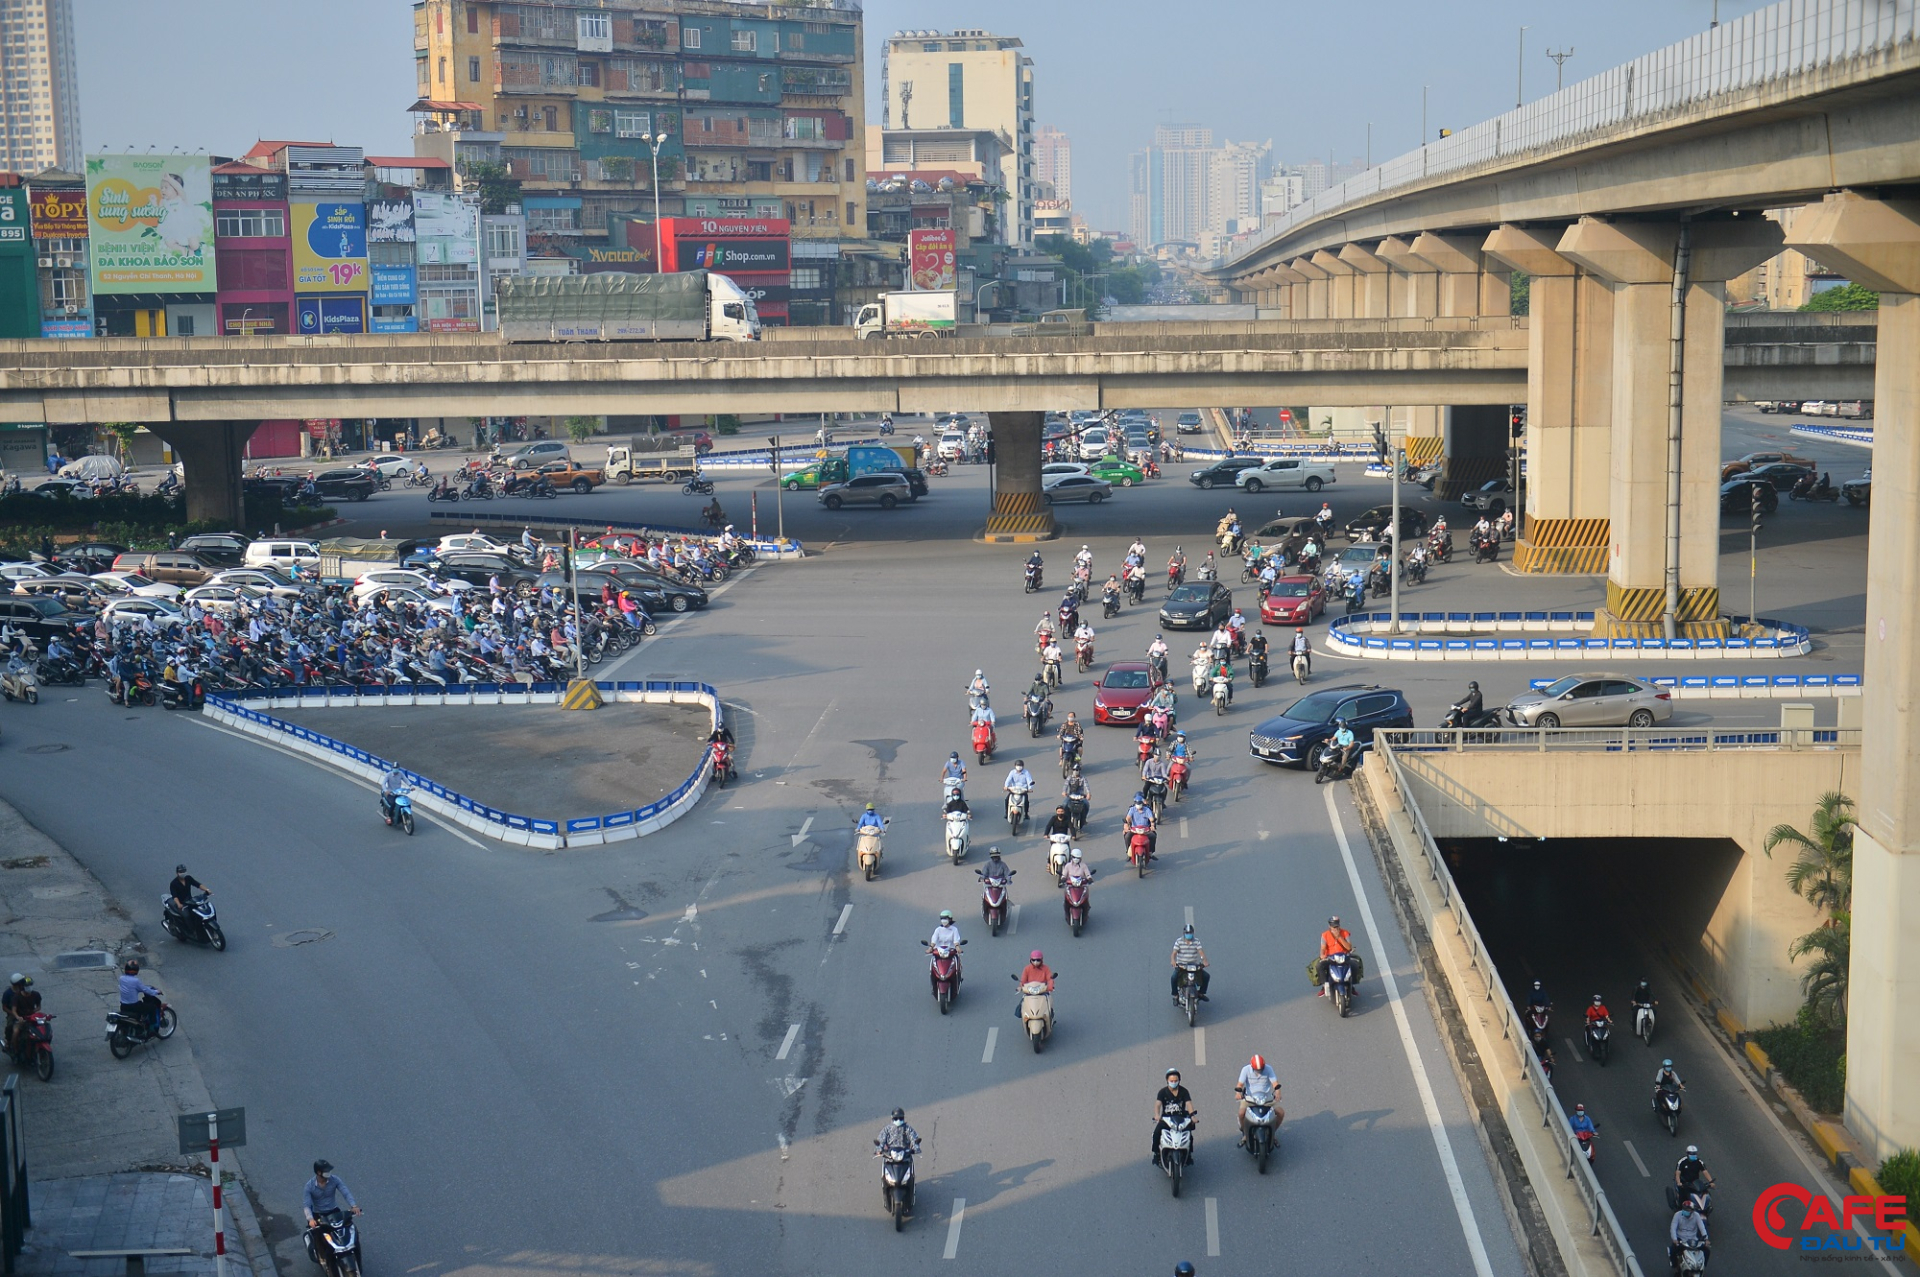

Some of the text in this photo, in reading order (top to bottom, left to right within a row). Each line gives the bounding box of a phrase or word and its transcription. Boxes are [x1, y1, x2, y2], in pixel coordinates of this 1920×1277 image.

[99, 187, 129, 205] Sinh
[234, 190, 247, 198] AN
[31, 202, 87, 218] TOPY
[98, 205, 128, 223] sung
[701, 220, 717, 233] 10
[1, 229, 21, 238] 895
[97, 241, 155, 255] BỆNH VIỆN
[98, 254, 204, 267] ĐA KHOA BẢO SƠN
[725, 250, 776, 264] Shop.com.vn
[103, 272, 112, 280] 52
[113, 271, 138, 280] Nguyễn
[175, 271, 185, 279] Hà
[186, 271, 197, 281] Nội
[298, 272, 326, 283] GIÁ TỐT
[743, 286, 767, 299] ÓP
[324, 314, 360, 323] KidsPlaza
[3, 443, 37, 451] Kagawa
